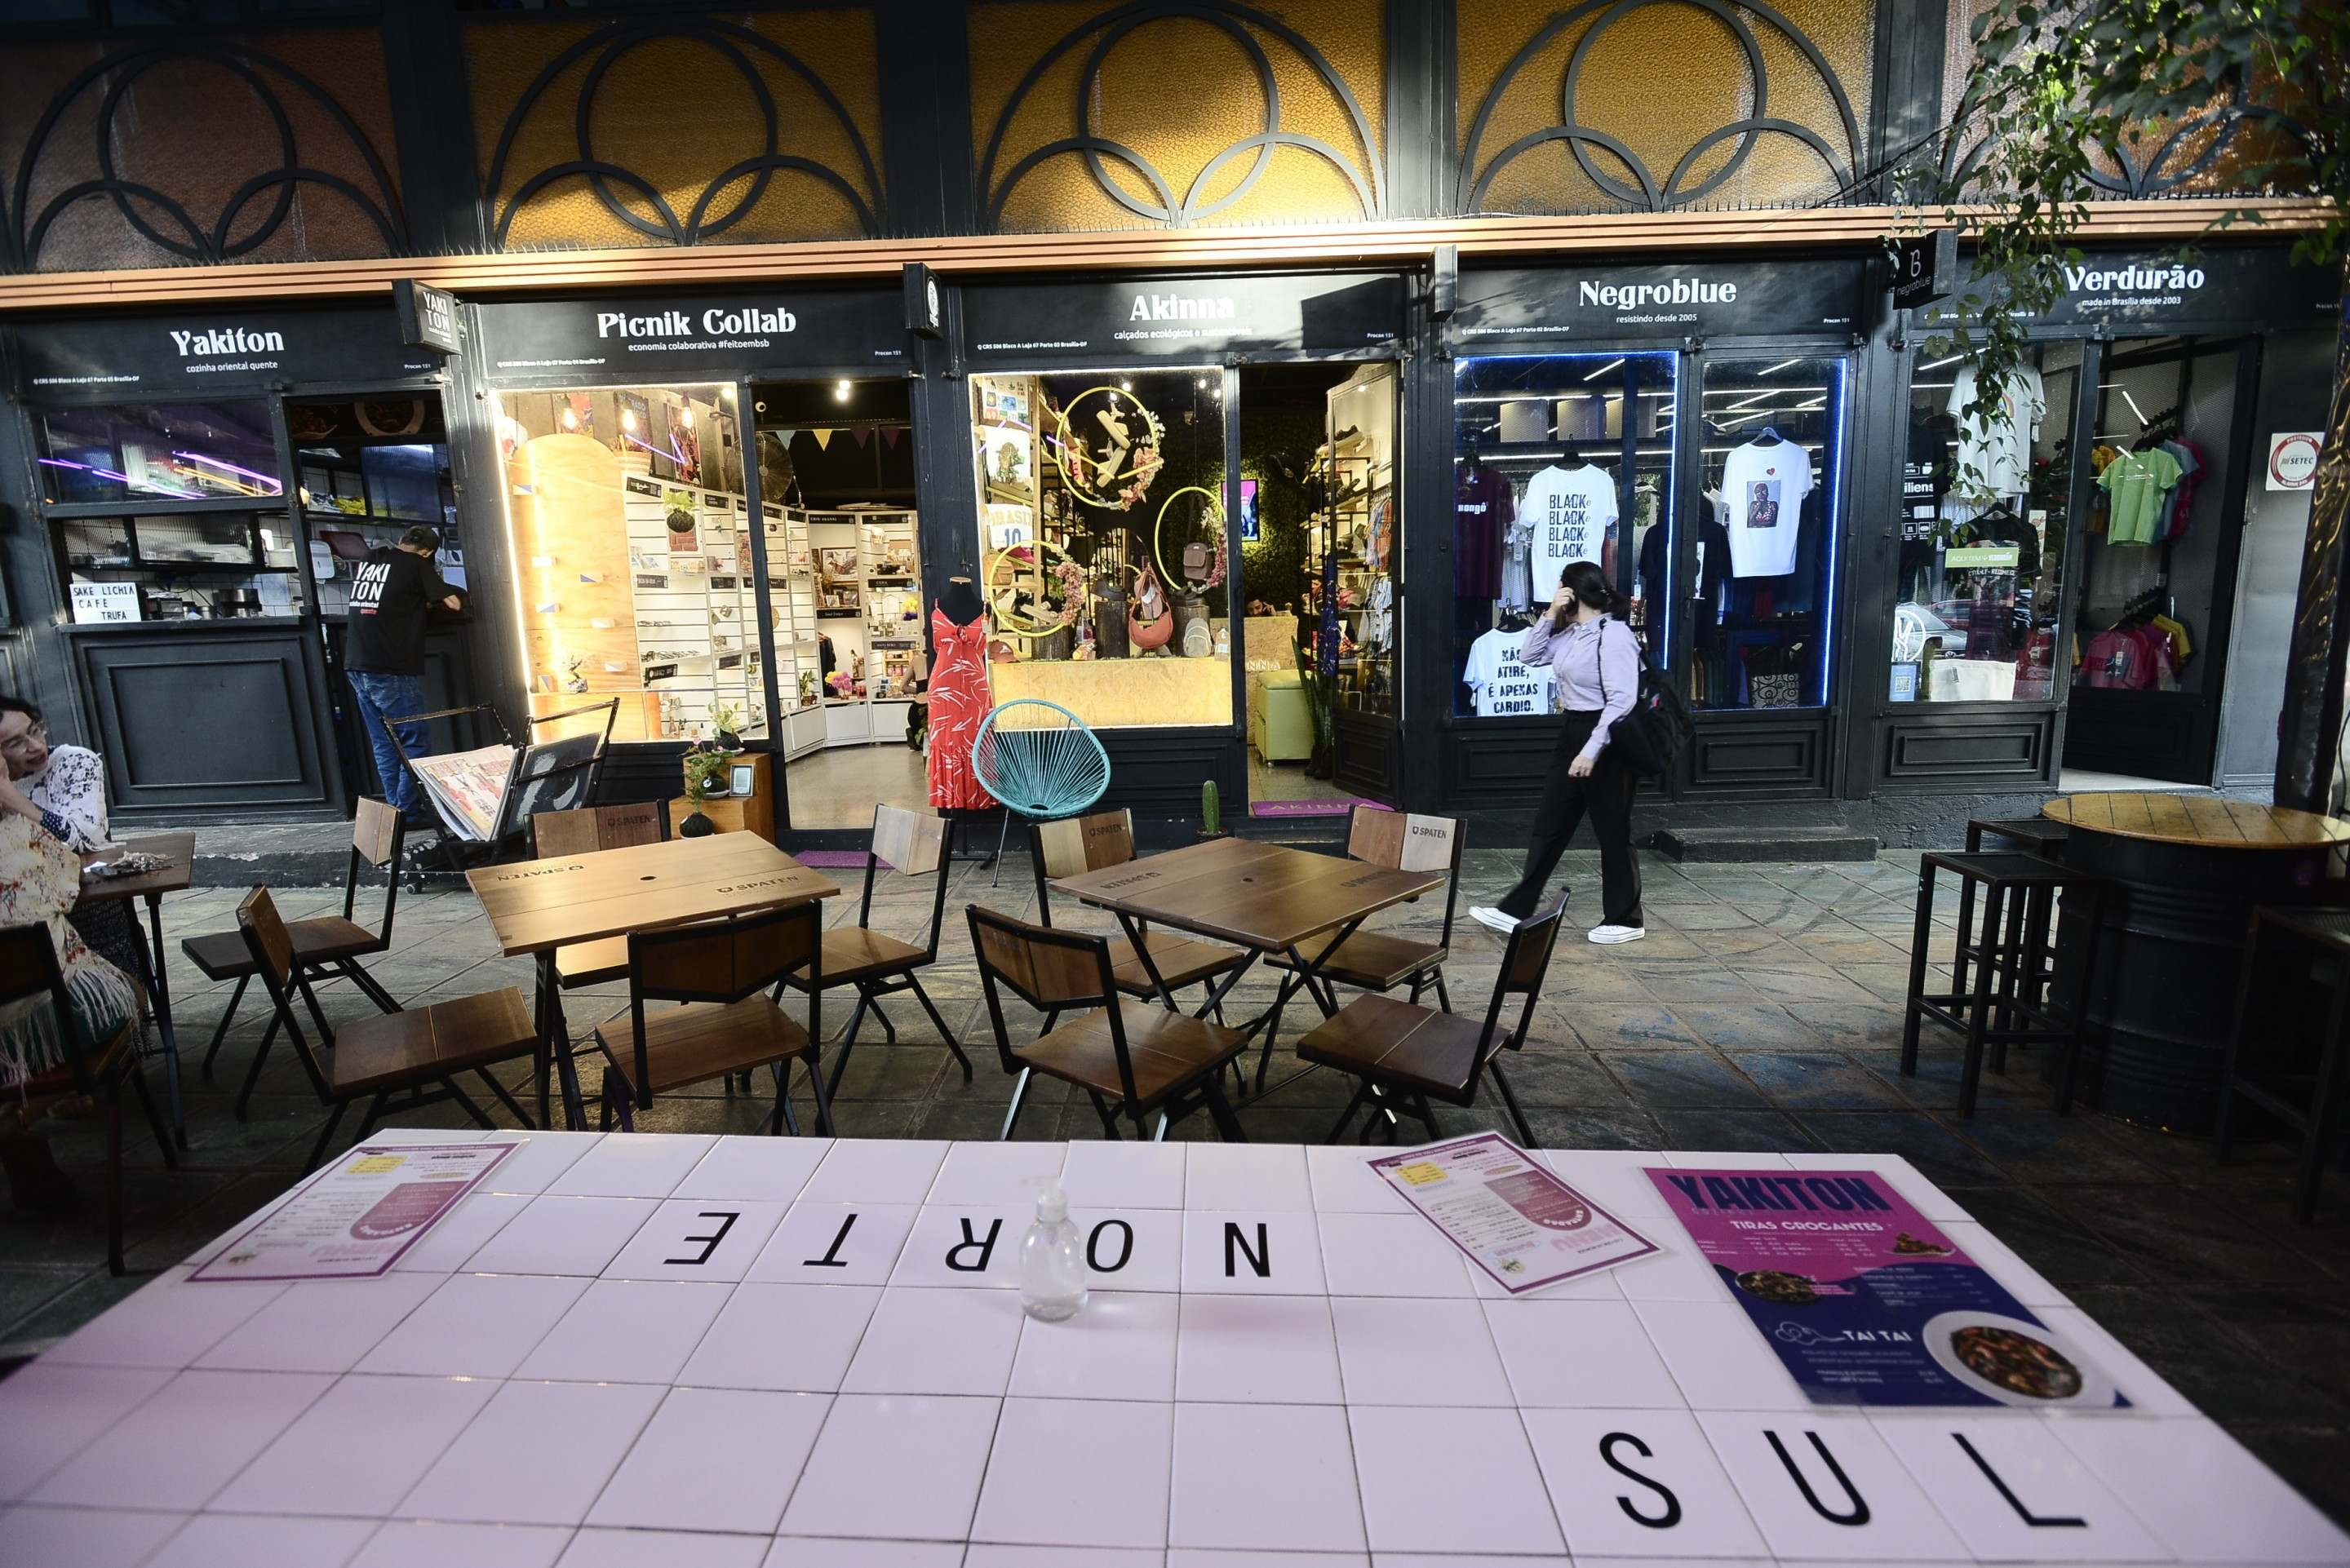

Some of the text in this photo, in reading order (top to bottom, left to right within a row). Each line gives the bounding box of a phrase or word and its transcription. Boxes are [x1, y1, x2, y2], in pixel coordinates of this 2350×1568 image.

[2064, 264, 2205, 291] Verdurão
[1580, 278, 1737, 310] Negroblue
[1896, 276, 1931, 297] negroblue
[423, 292, 448, 315] YAKI
[1129, 294, 1235, 321] Akinna
[2082, 299, 2103, 307] made
[2113, 297, 2138, 306] Brasília
[2139, 297, 2162, 305] desde
[2163, 296, 2181, 304] 2003
[425, 309, 450, 332] TON
[597, 308, 796, 339] Picnik Collab
[1616, 313, 1697, 323] resistindo desde 2005
[170, 327, 285, 356] Yakiton
[1114, 330, 1149, 341] calçados
[1151, 328, 1194, 339] ecológicos
[628, 339, 770, 352] economia colaborativa #feitoembsb
[186, 361, 278, 374] cozinha oriental quente
[2290, 457, 2313, 465] SETEC
[356, 562, 391, 582] YAKI
[73, 586, 135, 596] SAKE LICHIA
[350, 581, 384, 600] TON
[101, 611, 127, 620] TRUFA
[1497, 666, 1529, 679] ATIRE,
[1488, 682, 1538, 698] É APENAS
[1493, 700, 1534, 714] CARDIO.
[614, 816, 651, 827] SPATEN
[1097, 824, 1122, 836] SPATEN
[1419, 827, 1448, 839] SPATEN
[497, 867, 565, 883] SPATEN
[735, 875, 800, 891] SPATEN
[1665, 1174, 1894, 1211] YAKITON
[1730, 1220, 1884, 1231] TIRAS CROCANTES
[1842, 1330, 1913, 1341] TAI TAI
[1598, 1430, 2089, 1529] SUL
